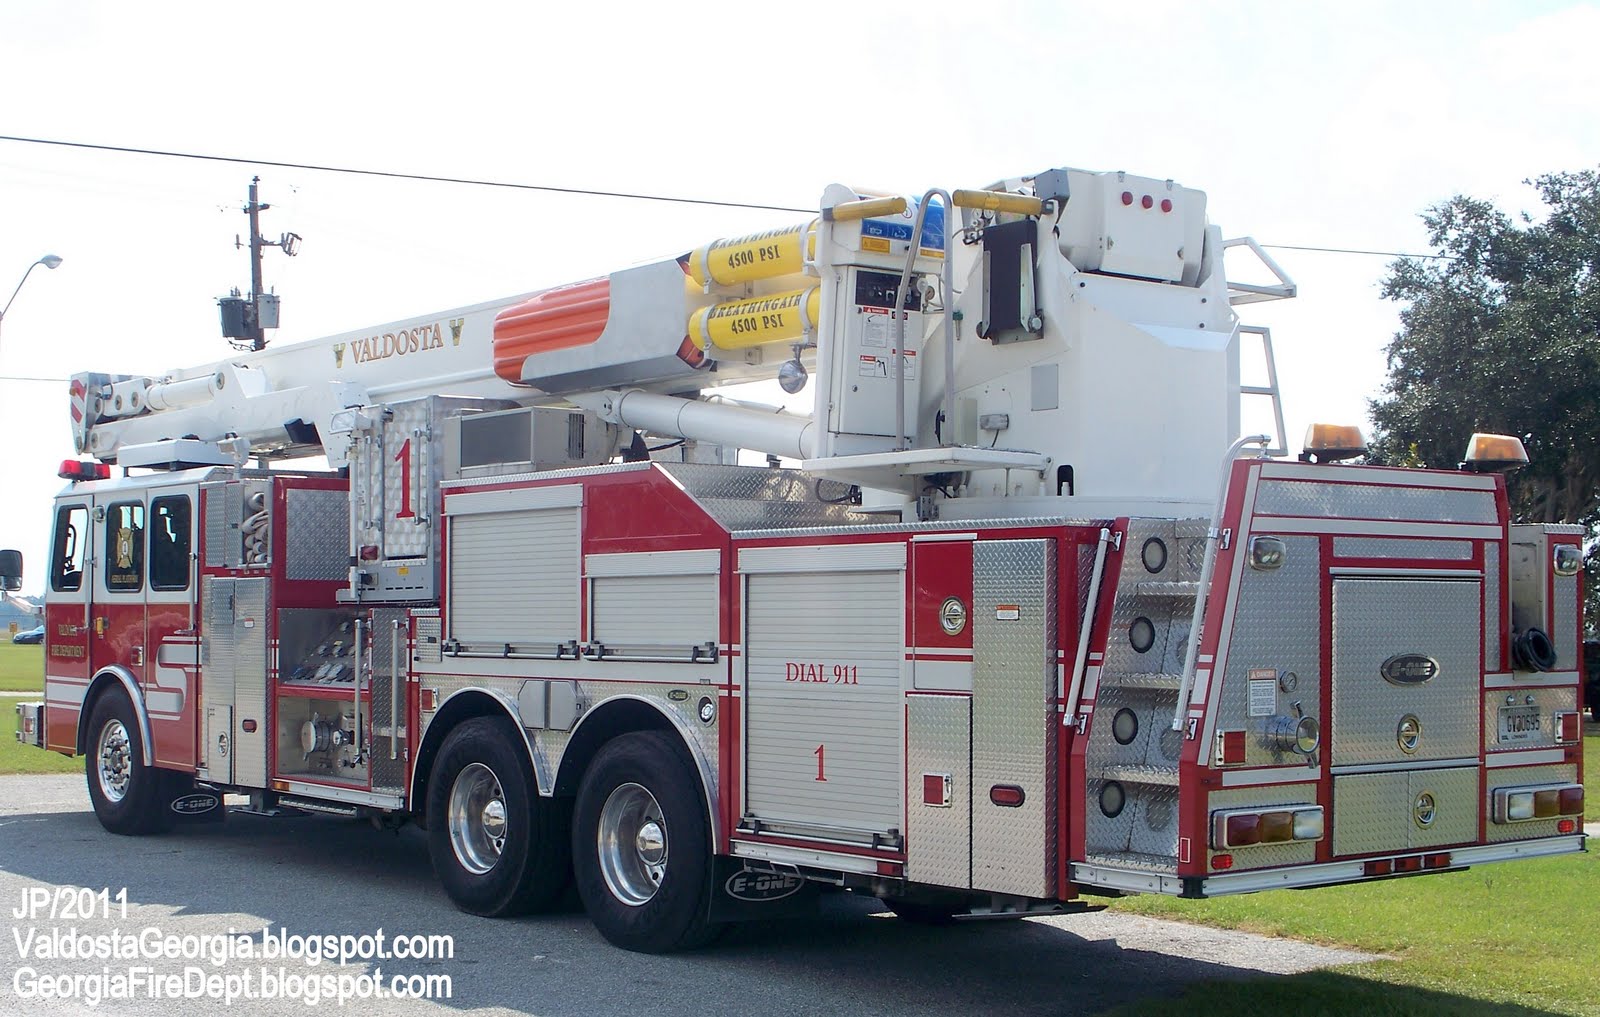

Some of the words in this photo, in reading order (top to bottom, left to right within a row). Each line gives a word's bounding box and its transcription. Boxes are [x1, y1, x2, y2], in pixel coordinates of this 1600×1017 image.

[728, 249, 754, 269] 4500
[759, 244, 781, 262] PSI
[731, 317, 758, 335] 4500
[762, 313, 785, 329] PSI
[350, 323, 444, 364] VALDOSTA
[394, 438, 416, 519] 1
[785, 662, 830, 683] DIAL
[833, 664, 859, 685] 911
[814, 744, 828, 782] 1
[176, 798, 214, 810] E-ONE
[733, 874, 797, 893] E-ONE
